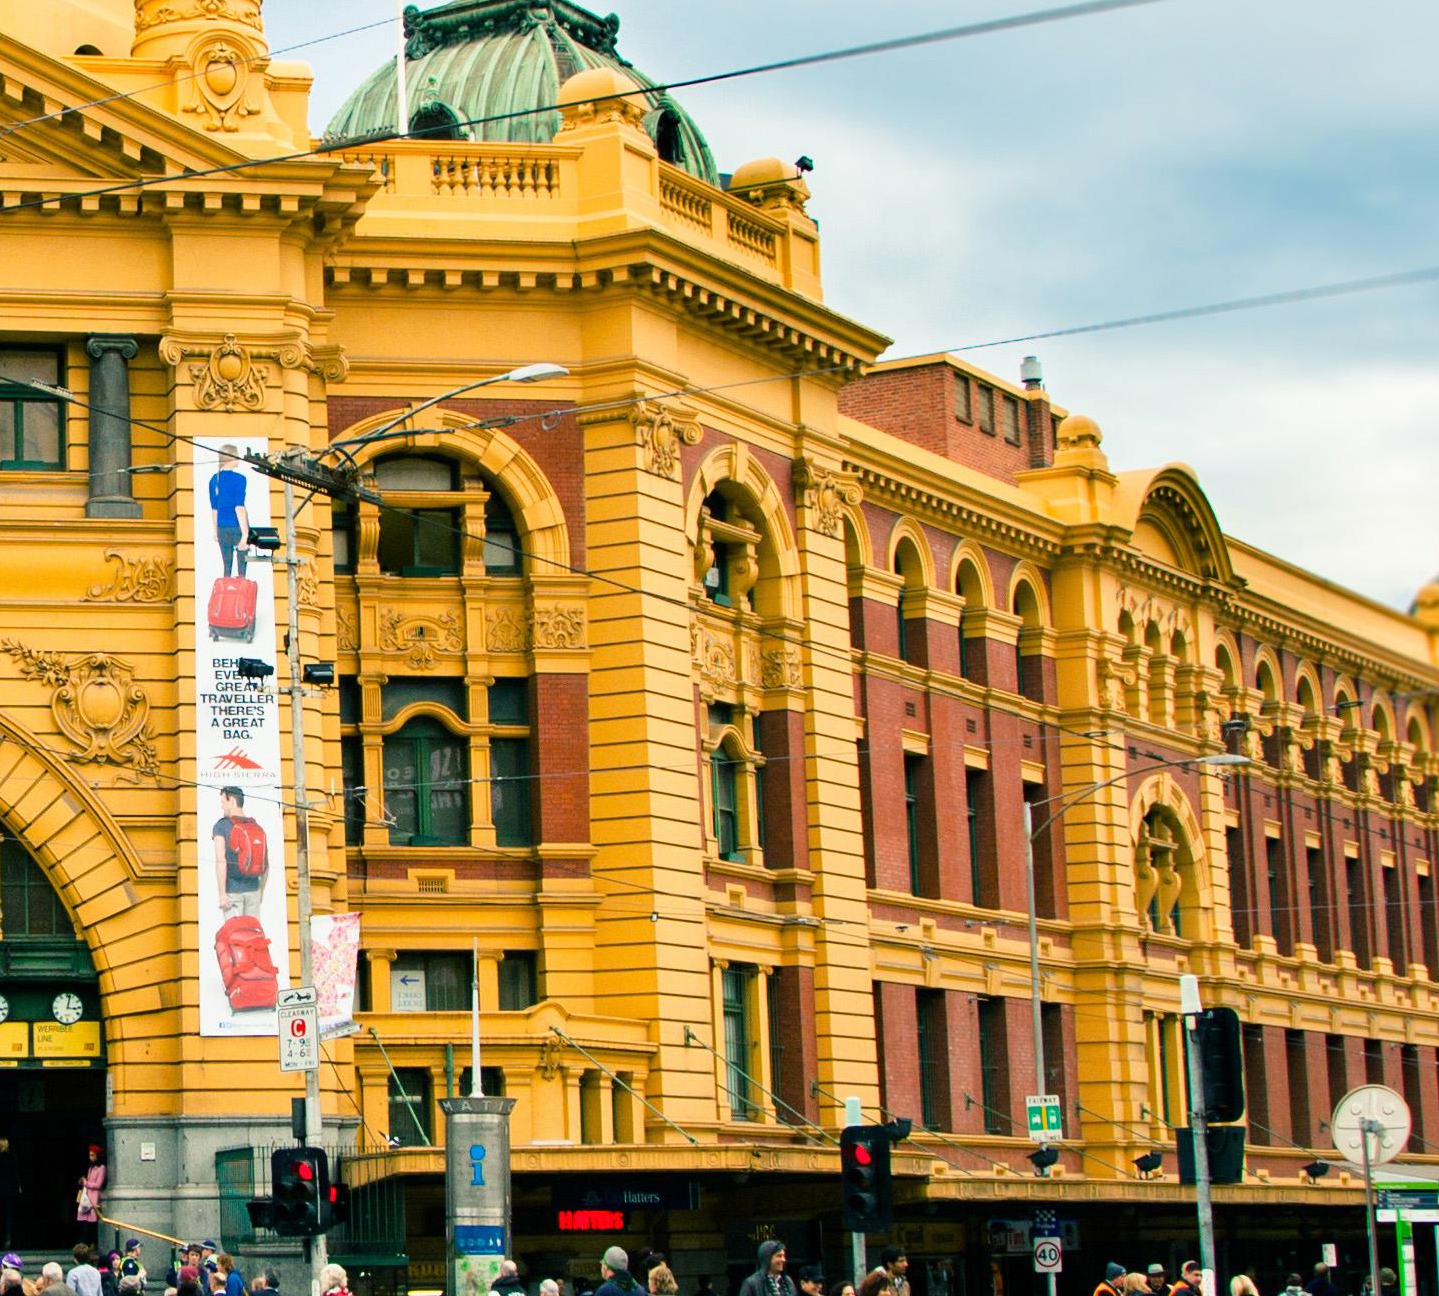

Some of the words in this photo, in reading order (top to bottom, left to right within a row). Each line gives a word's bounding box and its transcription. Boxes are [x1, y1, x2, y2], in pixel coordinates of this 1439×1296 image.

[200, 694, 274, 704] TRAVELLER
[210, 706, 265, 716] THERE'S
[211, 718, 219, 727] A
[222, 718, 265, 728] GREAT
[223, 730, 253, 739] BAG.
[280, 1009, 314, 1019] CLEARWAY
[37, 1034, 52, 1042] LINE
[623, 1190, 661, 1204] Hatters
[1038, 1248, 1057, 1261] 40
